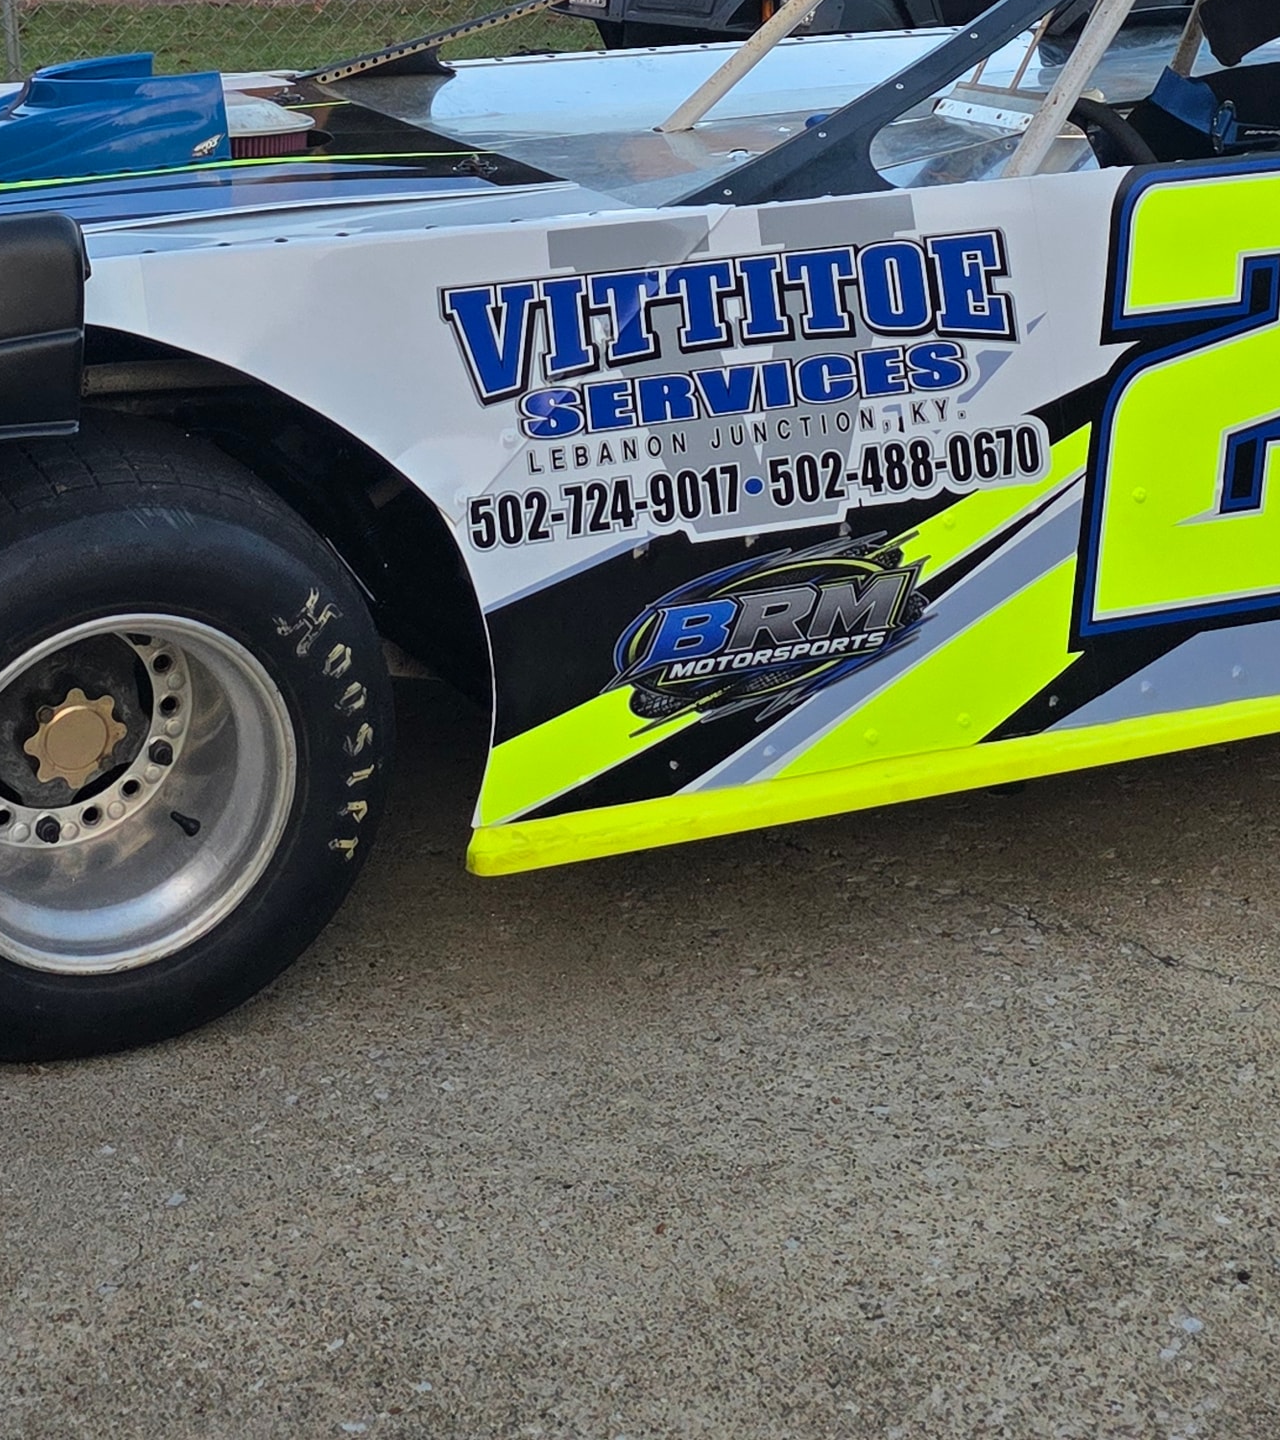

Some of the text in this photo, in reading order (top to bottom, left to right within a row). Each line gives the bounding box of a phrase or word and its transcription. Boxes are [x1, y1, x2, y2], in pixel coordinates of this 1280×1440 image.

[439, 229, 1018, 406] VITTITOE
[519, 339, 968, 441] SERVICES
[528, 432, 687, 474] LEBANON
[638, 571, 908, 672] BRM
[669, 630, 887, 681] MOTORSPORTS
